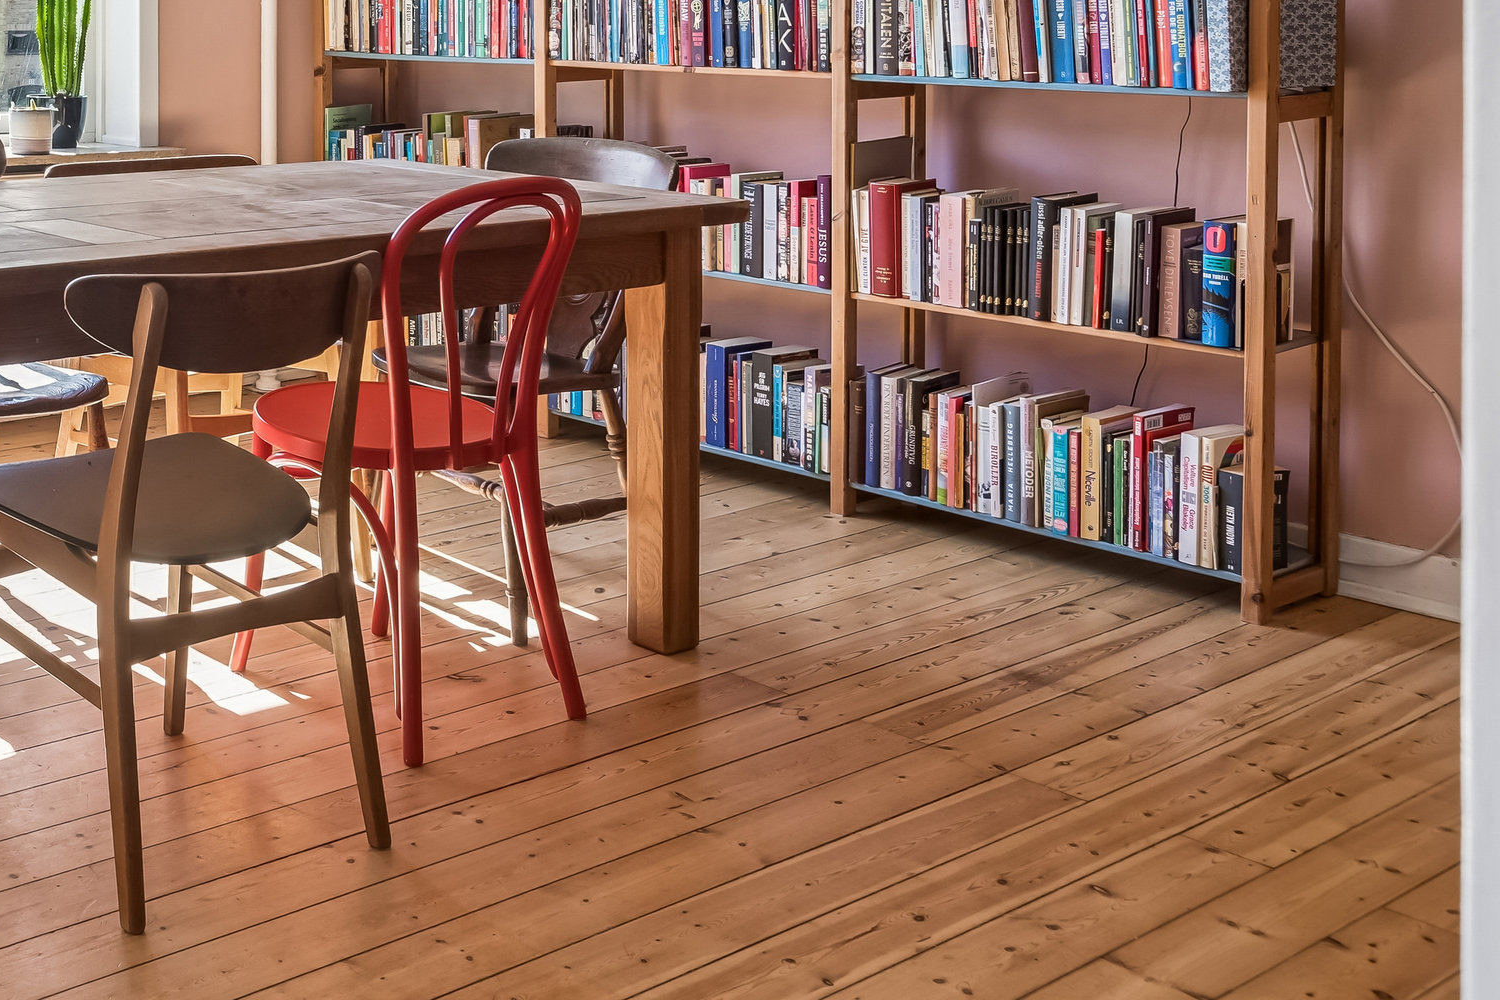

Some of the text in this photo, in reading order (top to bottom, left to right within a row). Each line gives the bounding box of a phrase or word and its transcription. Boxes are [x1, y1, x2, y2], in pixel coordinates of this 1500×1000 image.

[1056, 21, 1066, 40] LIBERTY
[1178, 14, 1187, 58] GODNATBOG
[1037, 202, 1046, 219] jussi
[818, 227, 827, 263] JESUS
[860, 227, 868, 244] GIVE
[1036, 220, 1045, 259] adler-olsen
[1164, 233, 1176, 326] TOVE DITLEVSEN
[754, 397, 770, 407] HAYES
[883, 383, 891, 399] DEN
[908, 425, 916, 465] GRUNDTVIG
[991, 444, 999, 486] BIROLLER
[1025, 450, 1034, 498] METODER
[1183, 456, 1191, 490] Capitalism
[1201, 465, 1214, 485] QUIZ
[1085, 470, 1097, 507] Niceville
[1181, 504, 1190, 532] Blakeley
[1189, 509, 1197, 530] Grace
[1226, 505, 1235, 546] NAOMI KLEIN
